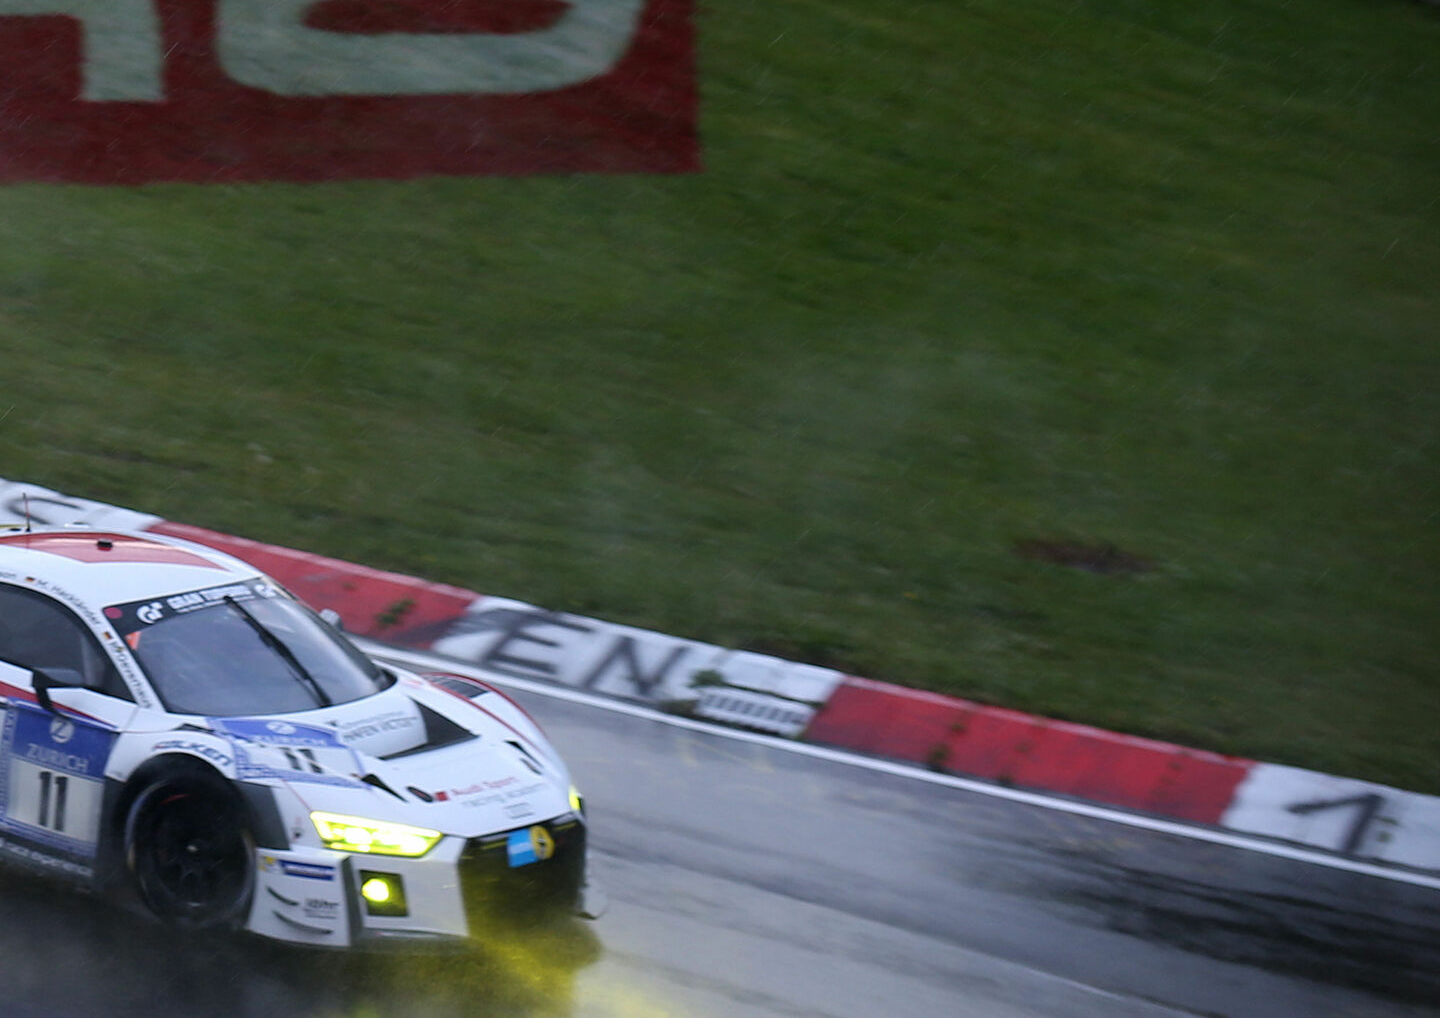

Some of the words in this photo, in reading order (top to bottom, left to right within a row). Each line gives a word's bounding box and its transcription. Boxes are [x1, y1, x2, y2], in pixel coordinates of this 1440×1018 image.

[27, 743, 89, 772] ZURICH
[278, 746, 324, 775] 11
[38, 771, 68, 832] 11
